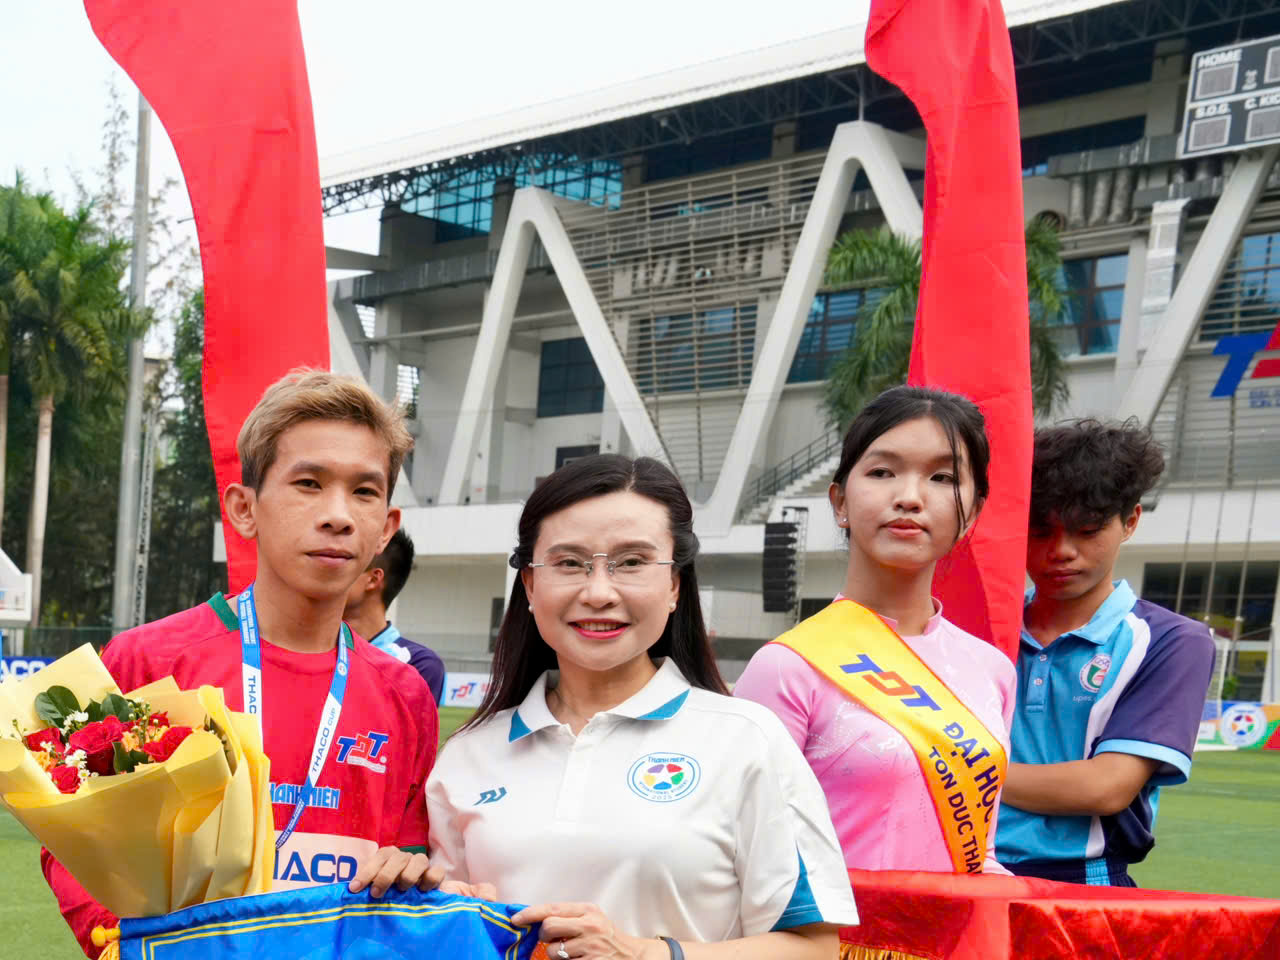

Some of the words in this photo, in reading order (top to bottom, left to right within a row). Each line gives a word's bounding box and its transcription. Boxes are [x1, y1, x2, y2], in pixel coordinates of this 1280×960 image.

[1198, 48, 1242, 68] HOME
[839, 653, 943, 712] TDT
[311, 727, 330, 772] THACO
[327, 707, 337, 726] CUP
[942, 721, 990, 768] ĐẠI
[928, 746, 958, 790] TON
[948, 791, 974, 836] DUC
